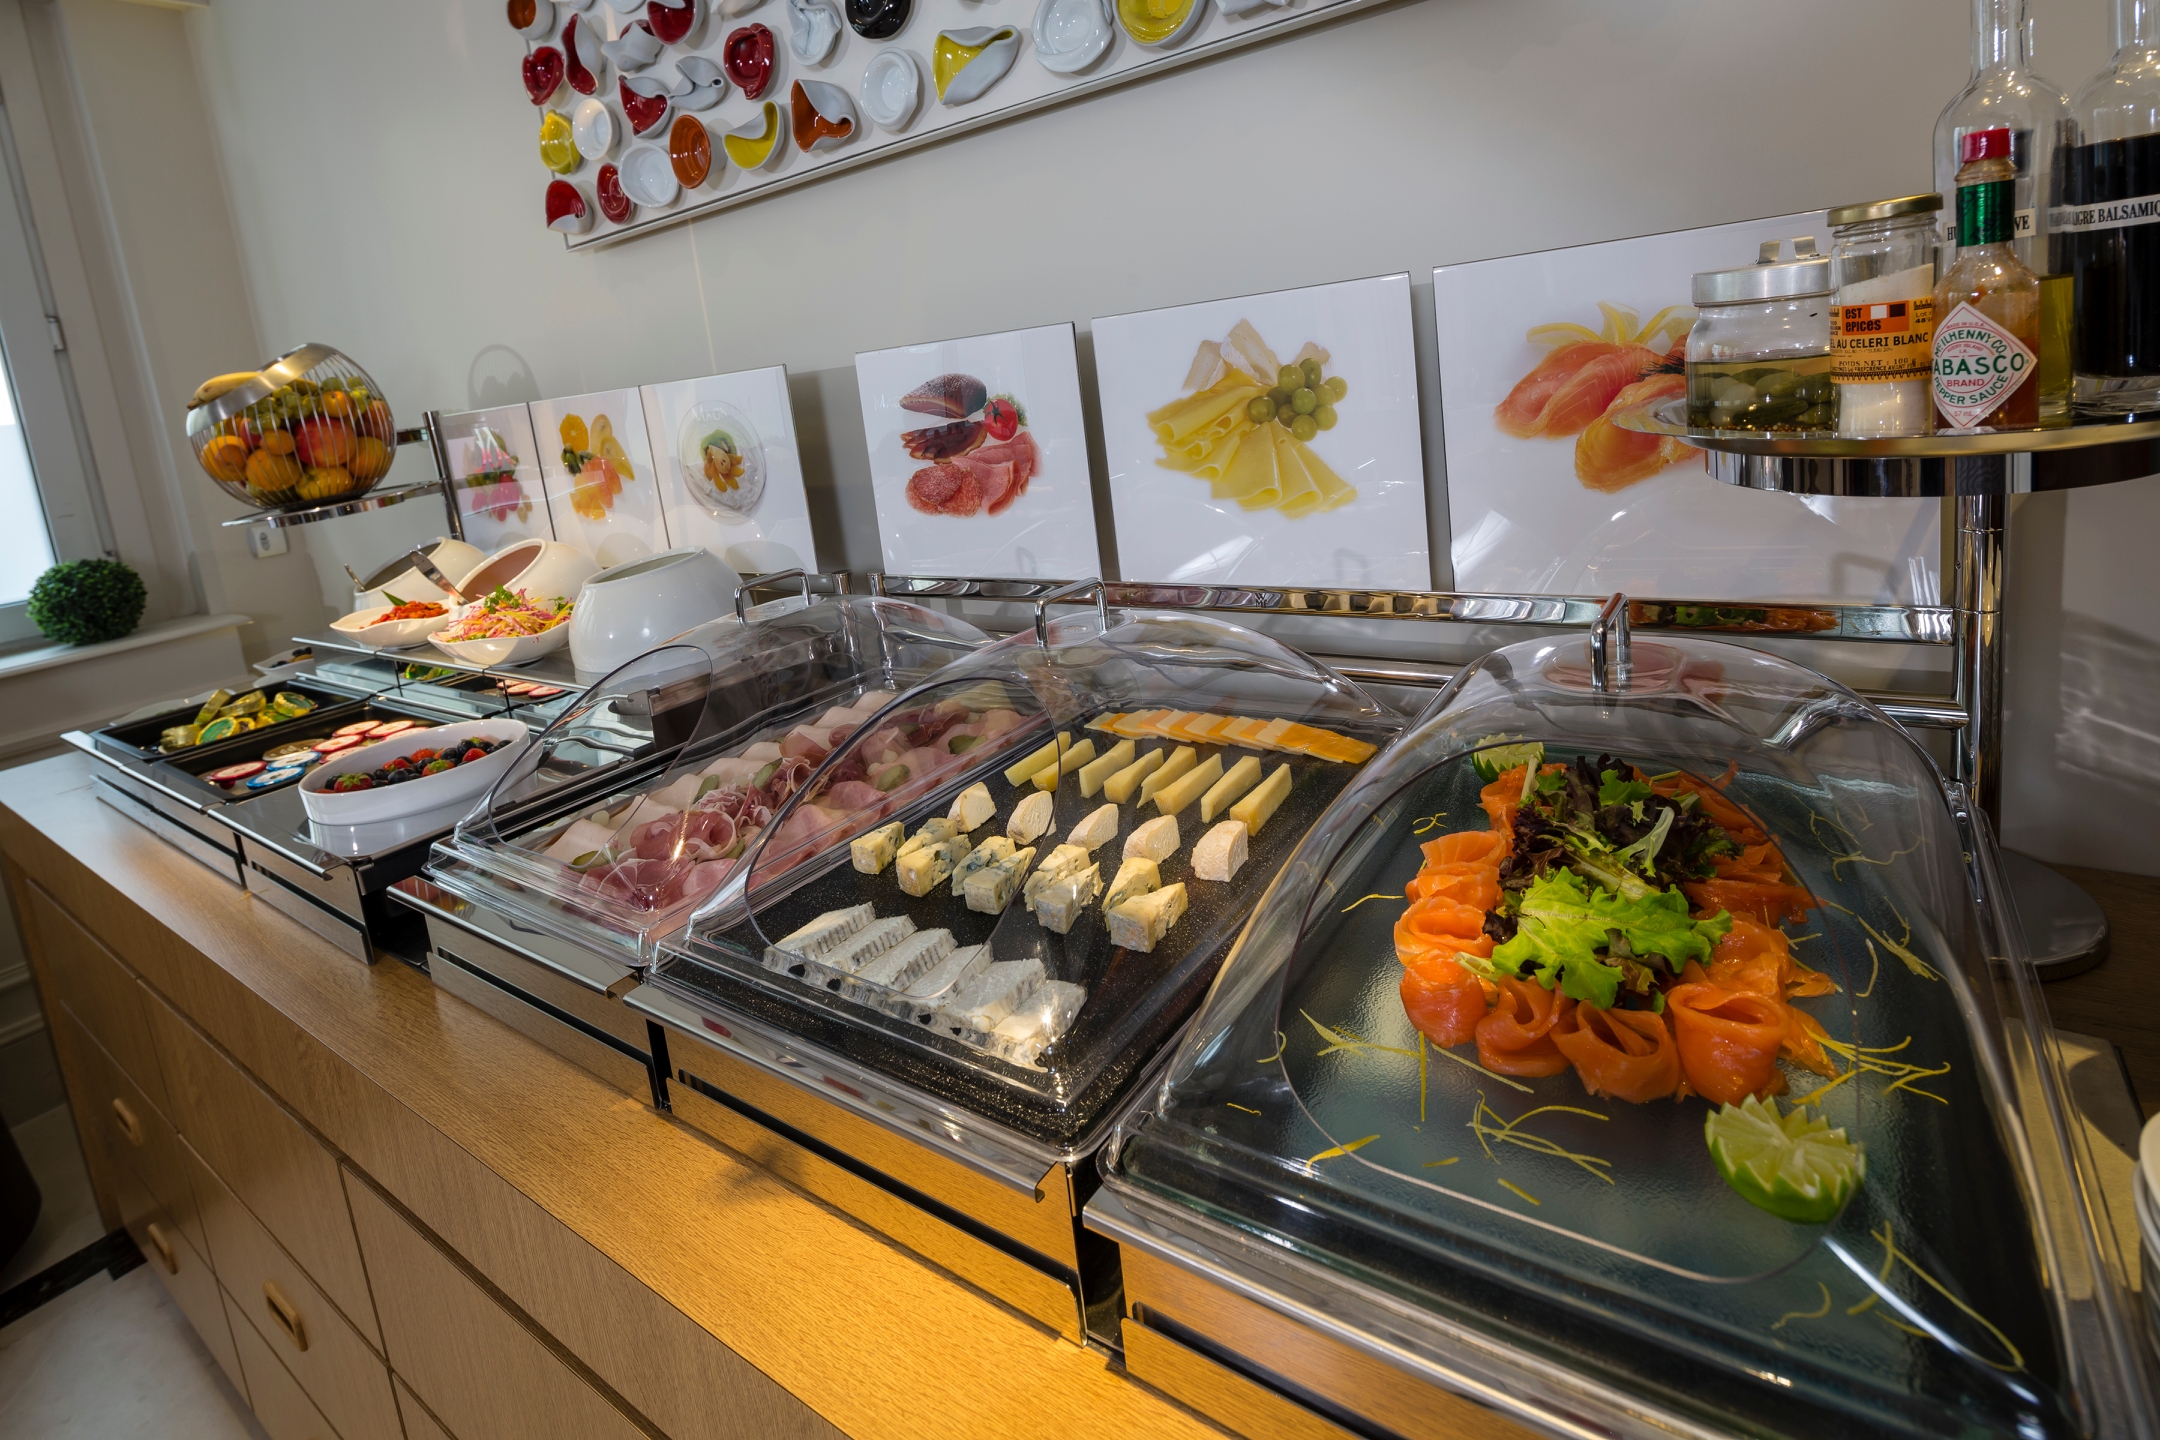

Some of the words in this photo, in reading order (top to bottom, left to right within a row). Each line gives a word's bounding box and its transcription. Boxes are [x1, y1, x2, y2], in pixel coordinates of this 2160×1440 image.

[1836, 339, 1847, 349] AU
[1849, 336, 1889, 349] CELERI
[1893, 332, 1929, 346] BLANC
[1863, 359, 1883, 367] NET
[1893, 357, 1909, 365] 100
[1932, 352, 2025, 376] ABASCO
[1934, 376, 1966, 405] PEPPER
[1970, 374, 2009, 404] SAUCE
[1946, 378, 1985, 388] BRAND
